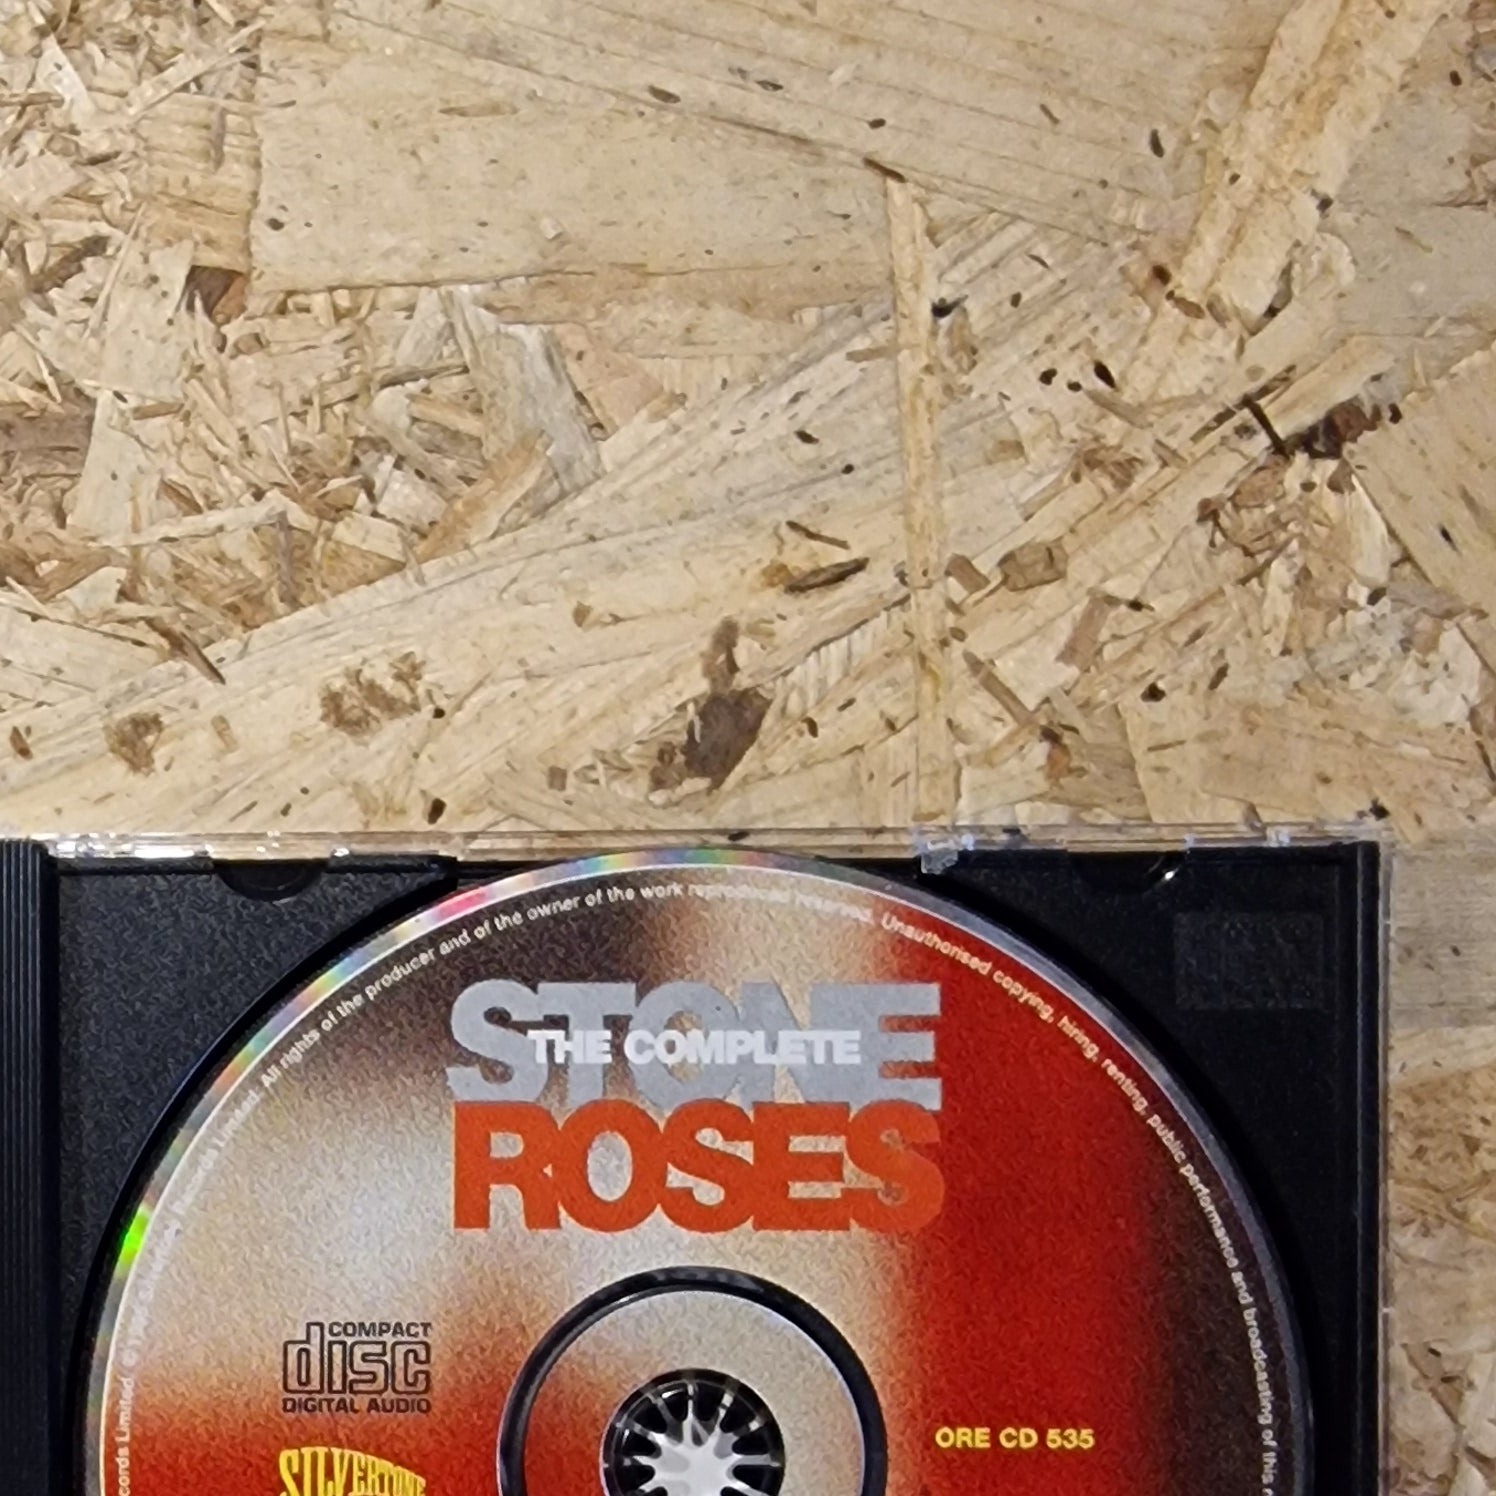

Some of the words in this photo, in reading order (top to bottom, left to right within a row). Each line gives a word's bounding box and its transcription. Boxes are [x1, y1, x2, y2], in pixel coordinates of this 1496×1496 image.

[584, 890, 603, 905] of
[606, 885, 635, 901] the
[640, 883, 683, 898] work
[493, 910, 523, 930] the
[527, 896, 580, 920] owner
[436, 930, 470, 954] and
[472, 920, 492, 938] of
[880, 914, 992, 975] Unauthorised
[363, 947, 436, 1000] producer
[336, 991, 365, 1017] the
[990, 967, 1060, 1024] copying,
[318, 1011, 338, 1031] of
[277, 1026, 322, 1071] rights
[446, 979, 942, 1110] STONE
[528, 1030, 611, 1064] THE
[624, 1029, 861, 1065] COMPLETE
[1055, 1015, 1105, 1063] hiring,
[260, 1064, 282, 1087] All
[1098, 1056, 1153, 1117] renting,
[1145, 1112, 1188, 1165] public
[453, 1098, 945, 1234] ROSES
[1179, 1162, 1240, 1269] performance
[1231, 1269, 1252, 1304] and
[328, 1321, 432, 1338] COMPACT
[1240, 1307, 1274, 1424] broadcasting
[116, 1377, 134, 1441] Limited
[282, 1397, 359, 1414] DIGITAL
[367, 1397, 432, 1414] AUDIO
[935, 1426, 992, 1449] ORE
[999, 1427, 1039, 1449] CD
[1046, 1428, 1095, 1450] 535
[1261, 1429, 1275, 1447] of
[1261, 1452, 1275, 1484] this
